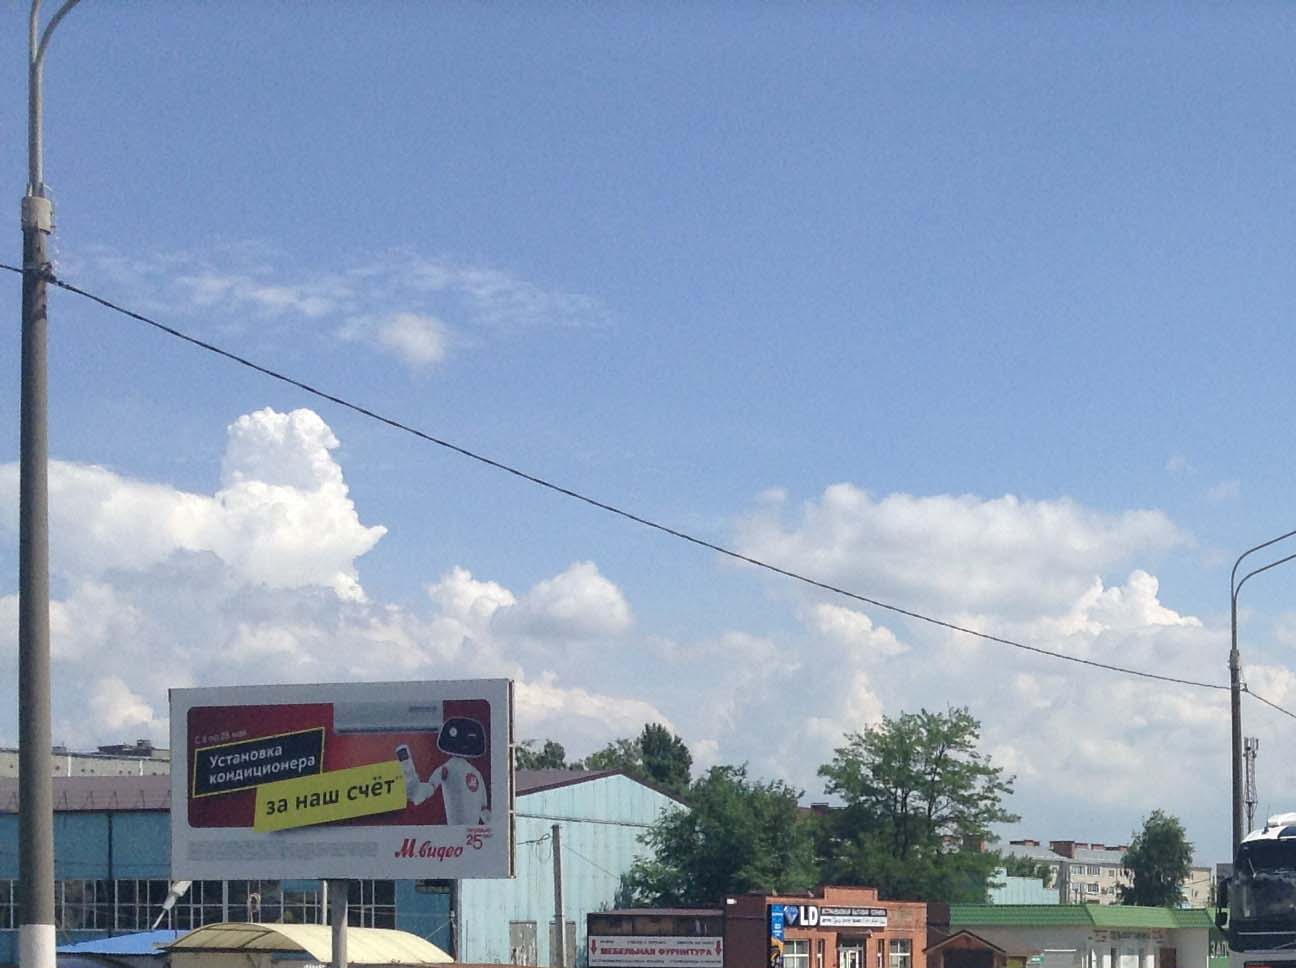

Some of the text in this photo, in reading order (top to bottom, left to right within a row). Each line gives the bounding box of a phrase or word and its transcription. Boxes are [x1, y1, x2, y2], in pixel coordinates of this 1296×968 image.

[208, 745, 282, 769] Установка
[208, 755, 316, 785] кондиционера
[266, 775, 395, 816] за наш счёт
[394, 837, 464, 862] М.видео
[466, 833, 484, 850] 25
[800, 905, 818, 926] LD
